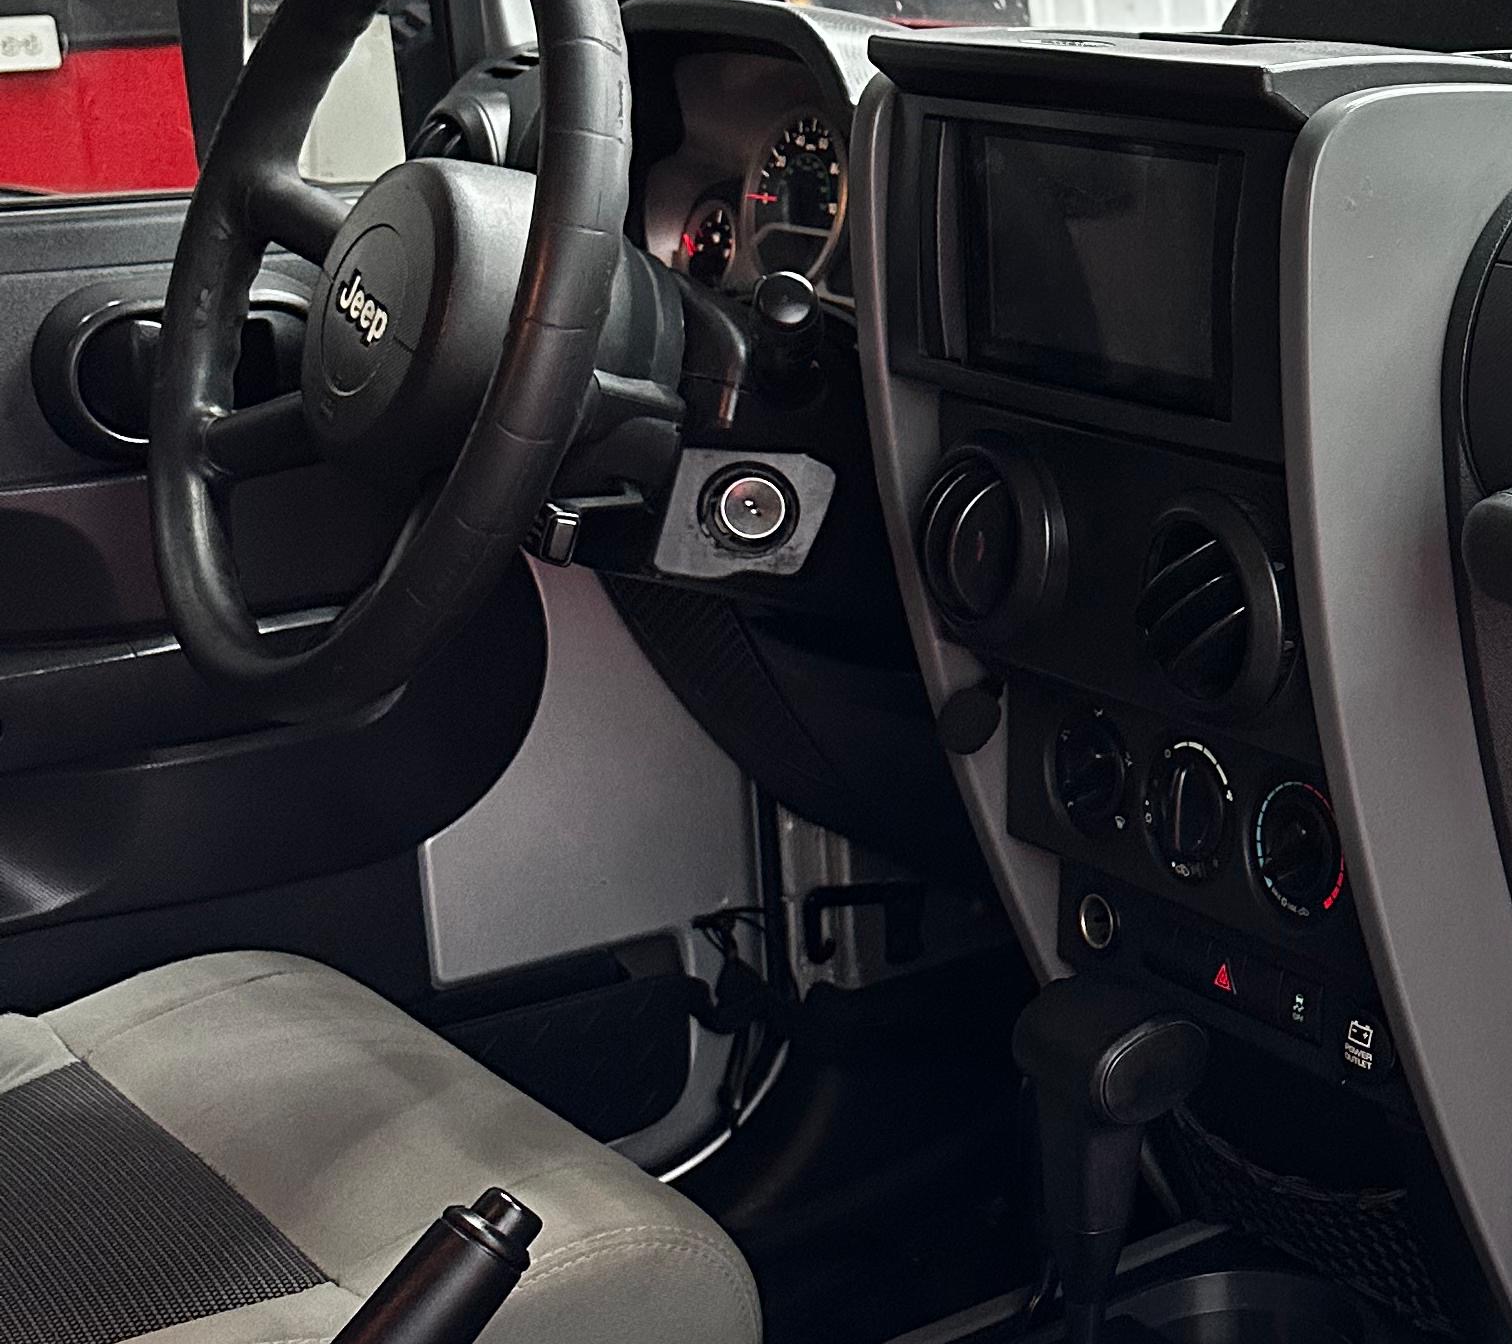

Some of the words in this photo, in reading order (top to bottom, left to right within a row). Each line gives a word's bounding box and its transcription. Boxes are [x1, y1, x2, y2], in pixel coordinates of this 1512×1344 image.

[339, 273, 388, 343] Jeep
[1343, 1042, 1373, 1061] POWER
[1343, 1051, 1373, 1070] OUTLET
